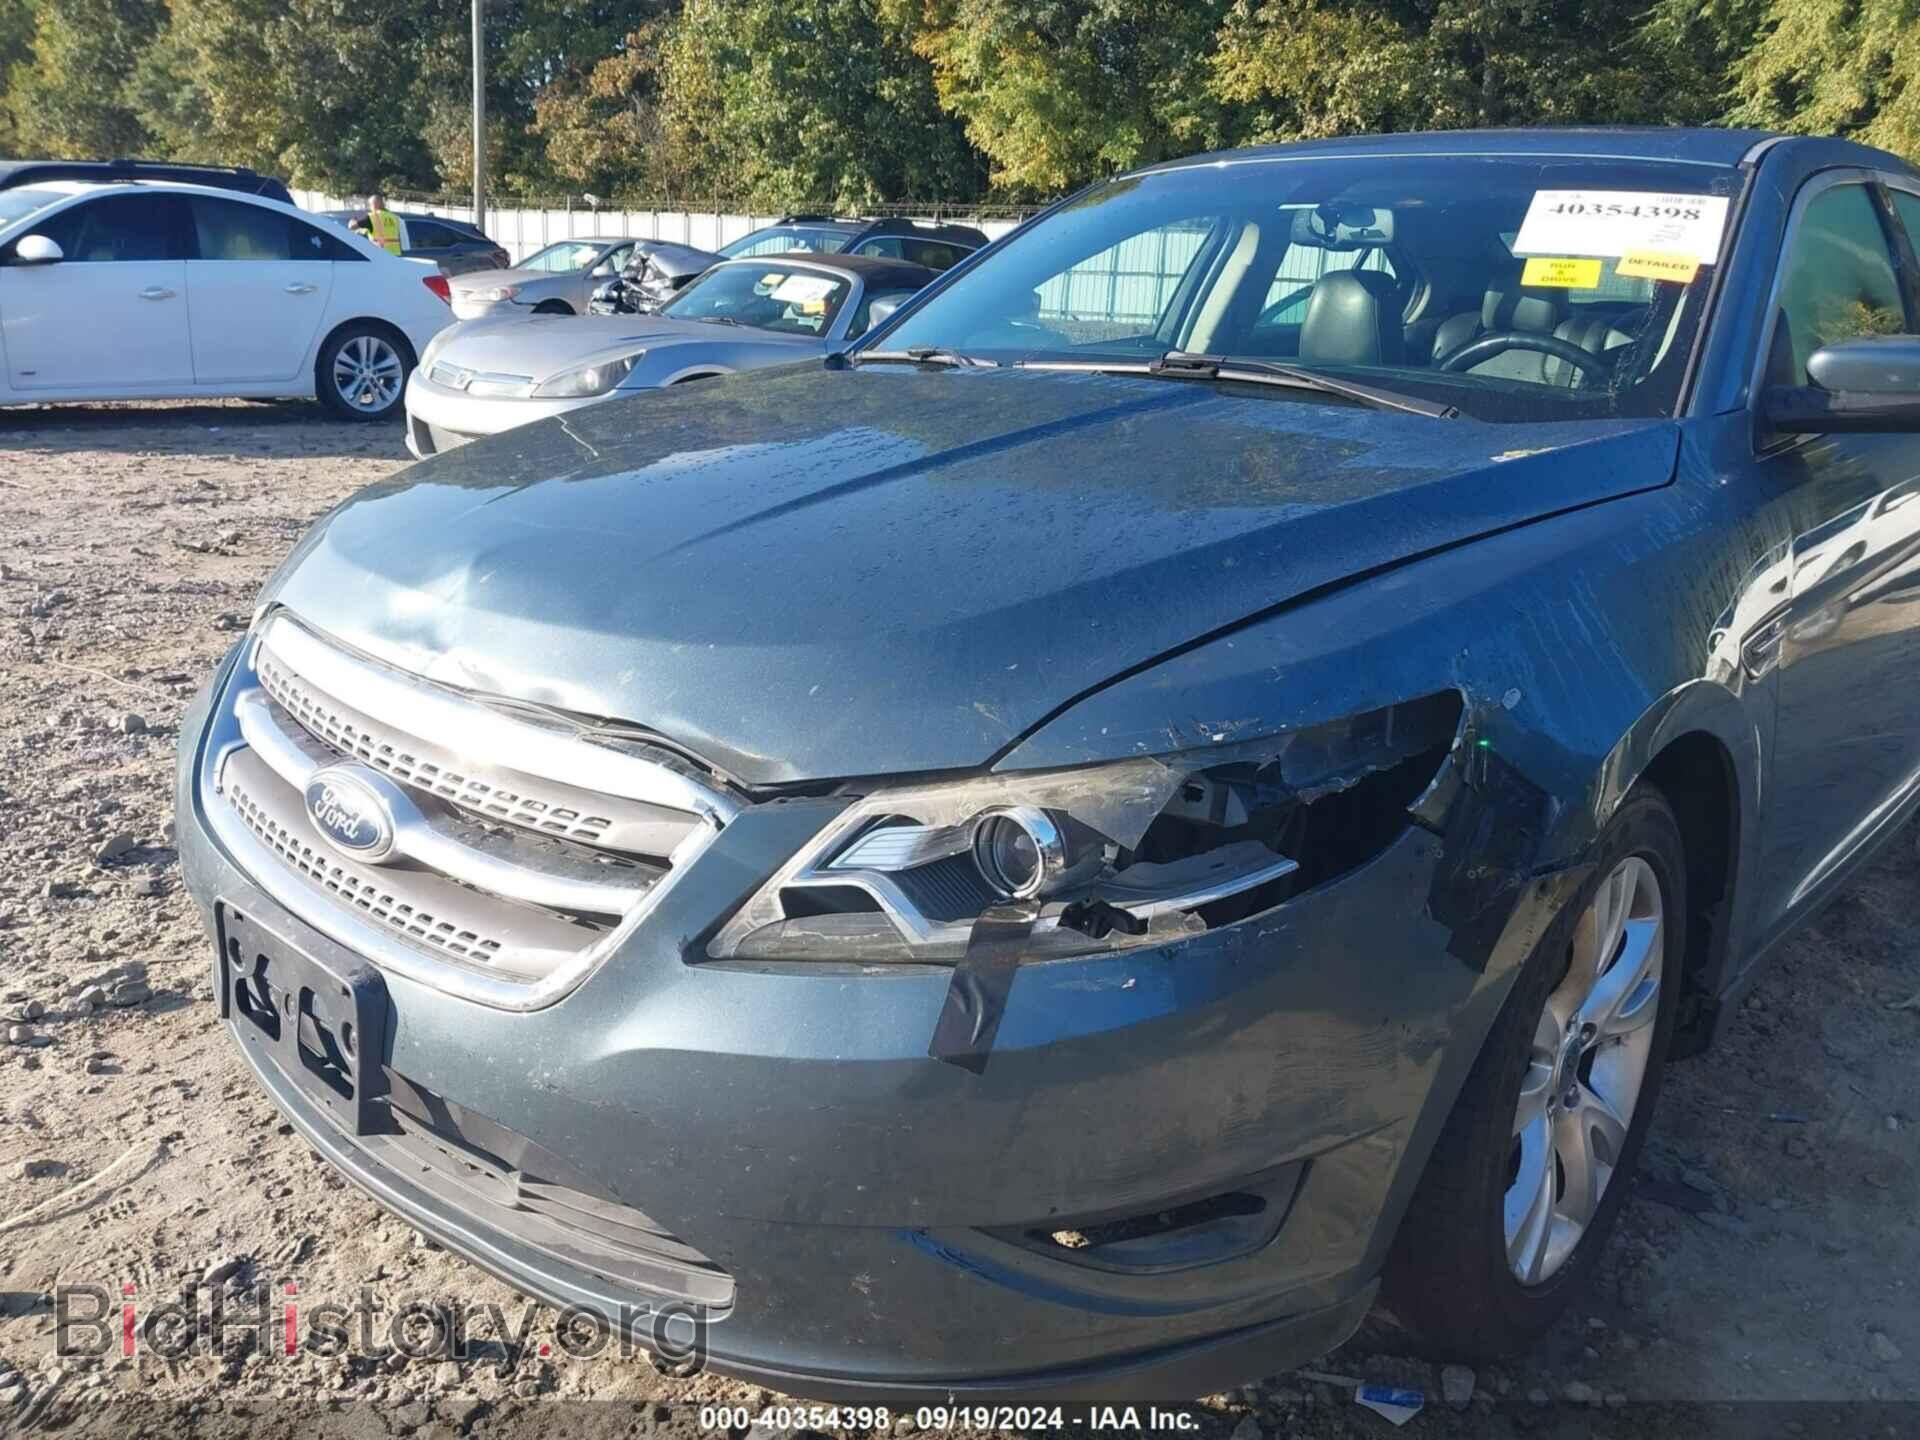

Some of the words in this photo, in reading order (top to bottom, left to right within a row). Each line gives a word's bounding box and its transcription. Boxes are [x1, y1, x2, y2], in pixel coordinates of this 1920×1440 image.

[1549, 202, 1702, 220] 40354398
[1628, 258, 1690, 271] DETAILED
[1540, 275, 1577, 284] DRIVE
[314, 786, 360, 840] Ford
